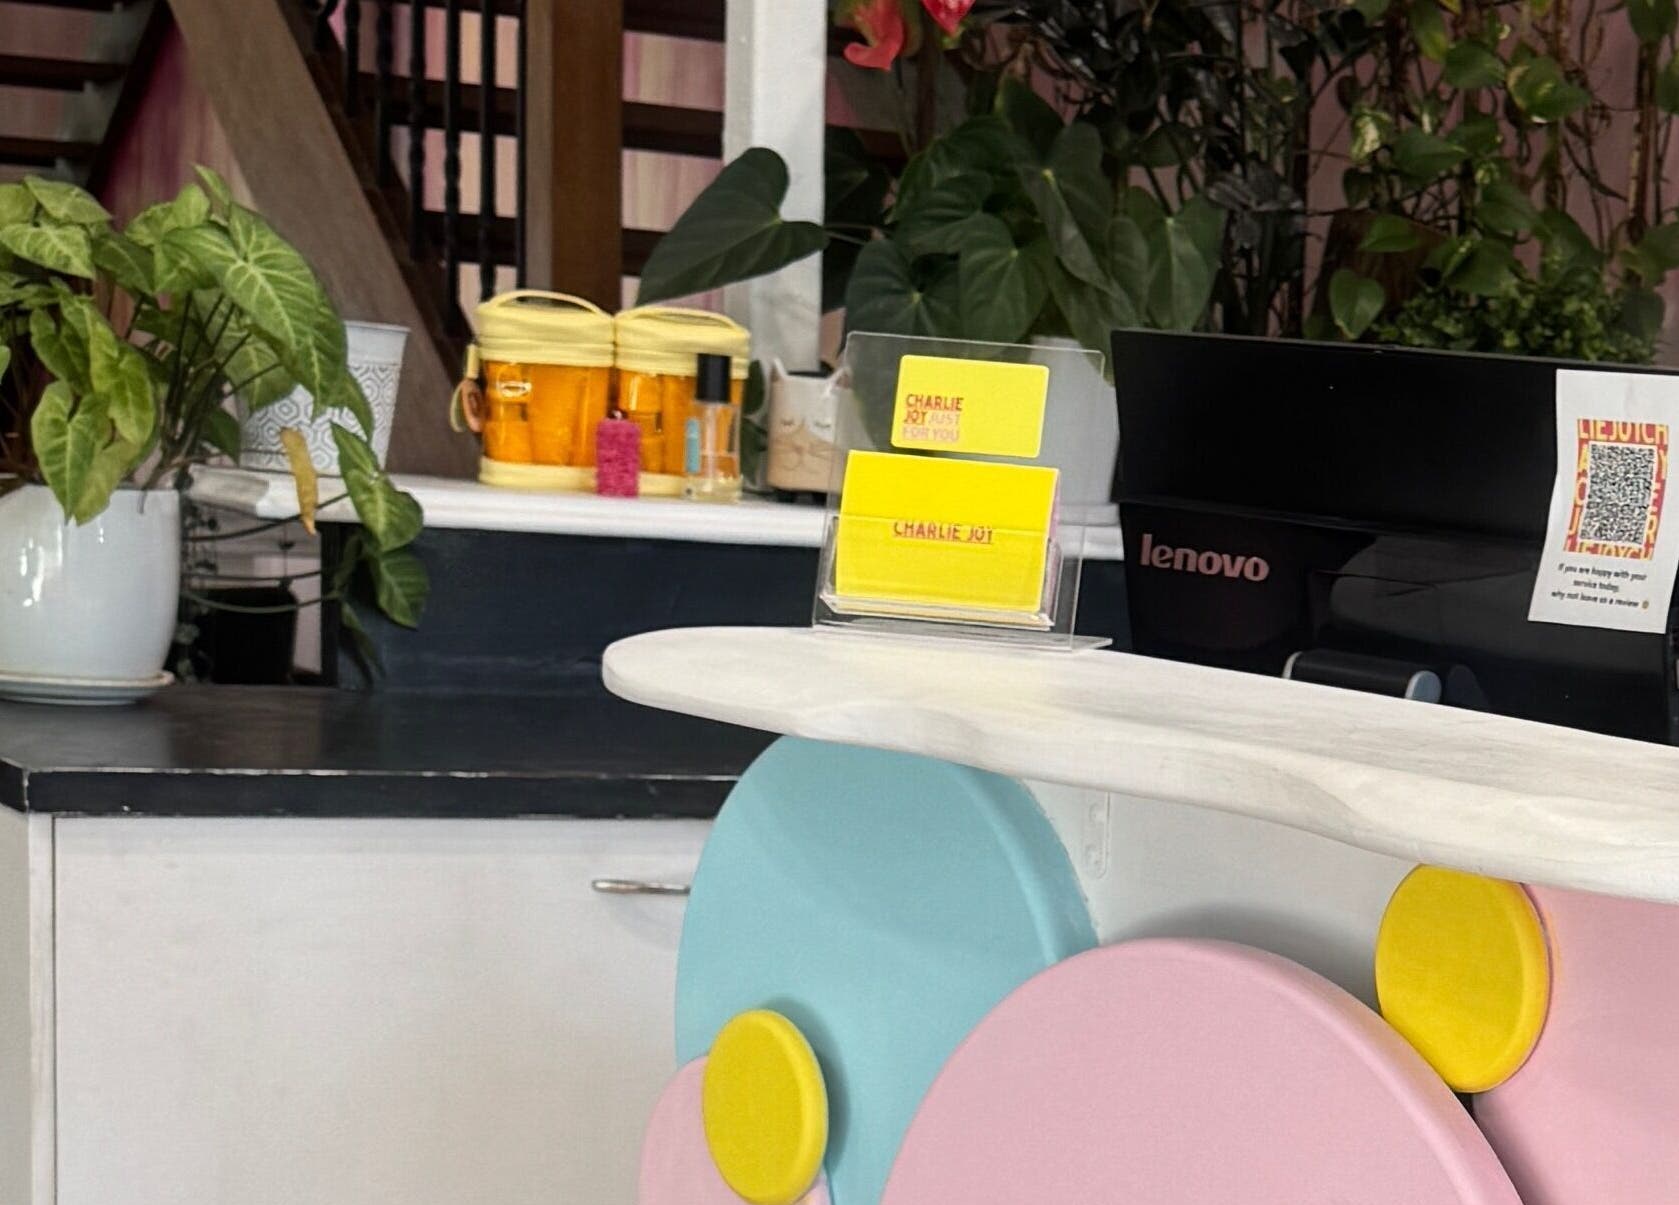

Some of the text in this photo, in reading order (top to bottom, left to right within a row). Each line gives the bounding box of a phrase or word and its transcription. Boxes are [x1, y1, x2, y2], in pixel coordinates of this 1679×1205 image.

[905, 393, 965, 412] CHARLIE
[903, 409, 961, 426] JOY JUST
[903, 426, 961, 443] FOR YOU
[893, 521, 993, 545] CHARLIE JOY
[1139, 533, 1270, 582] lenovo
[1591, 566, 1612, 579] happy
